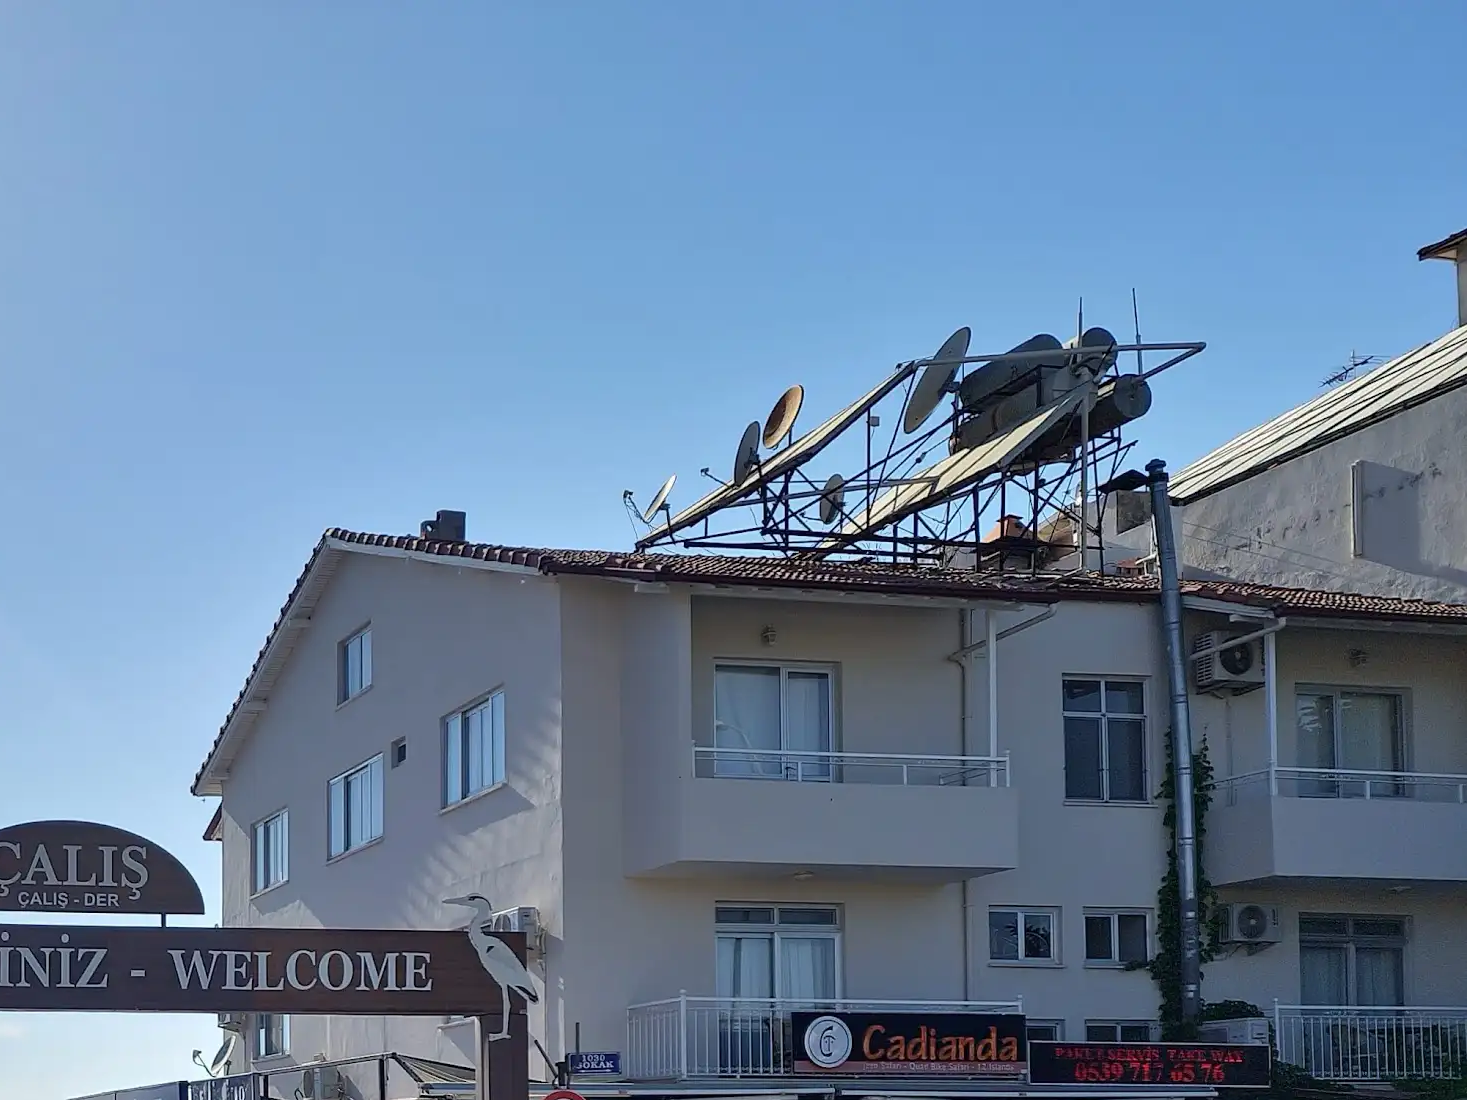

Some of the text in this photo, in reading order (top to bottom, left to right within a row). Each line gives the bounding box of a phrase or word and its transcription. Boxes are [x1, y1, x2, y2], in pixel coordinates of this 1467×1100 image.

[17, 891, 69, 909] ÇALIŞ
[83, 893, 120, 908] DER
[166, 949, 434, 993] WELCOME
[862, 1024, 1019, 1062] Cadianda
[575, 1061, 615, 1070] SOKAK
[582, 1054, 605, 1063] 1030
